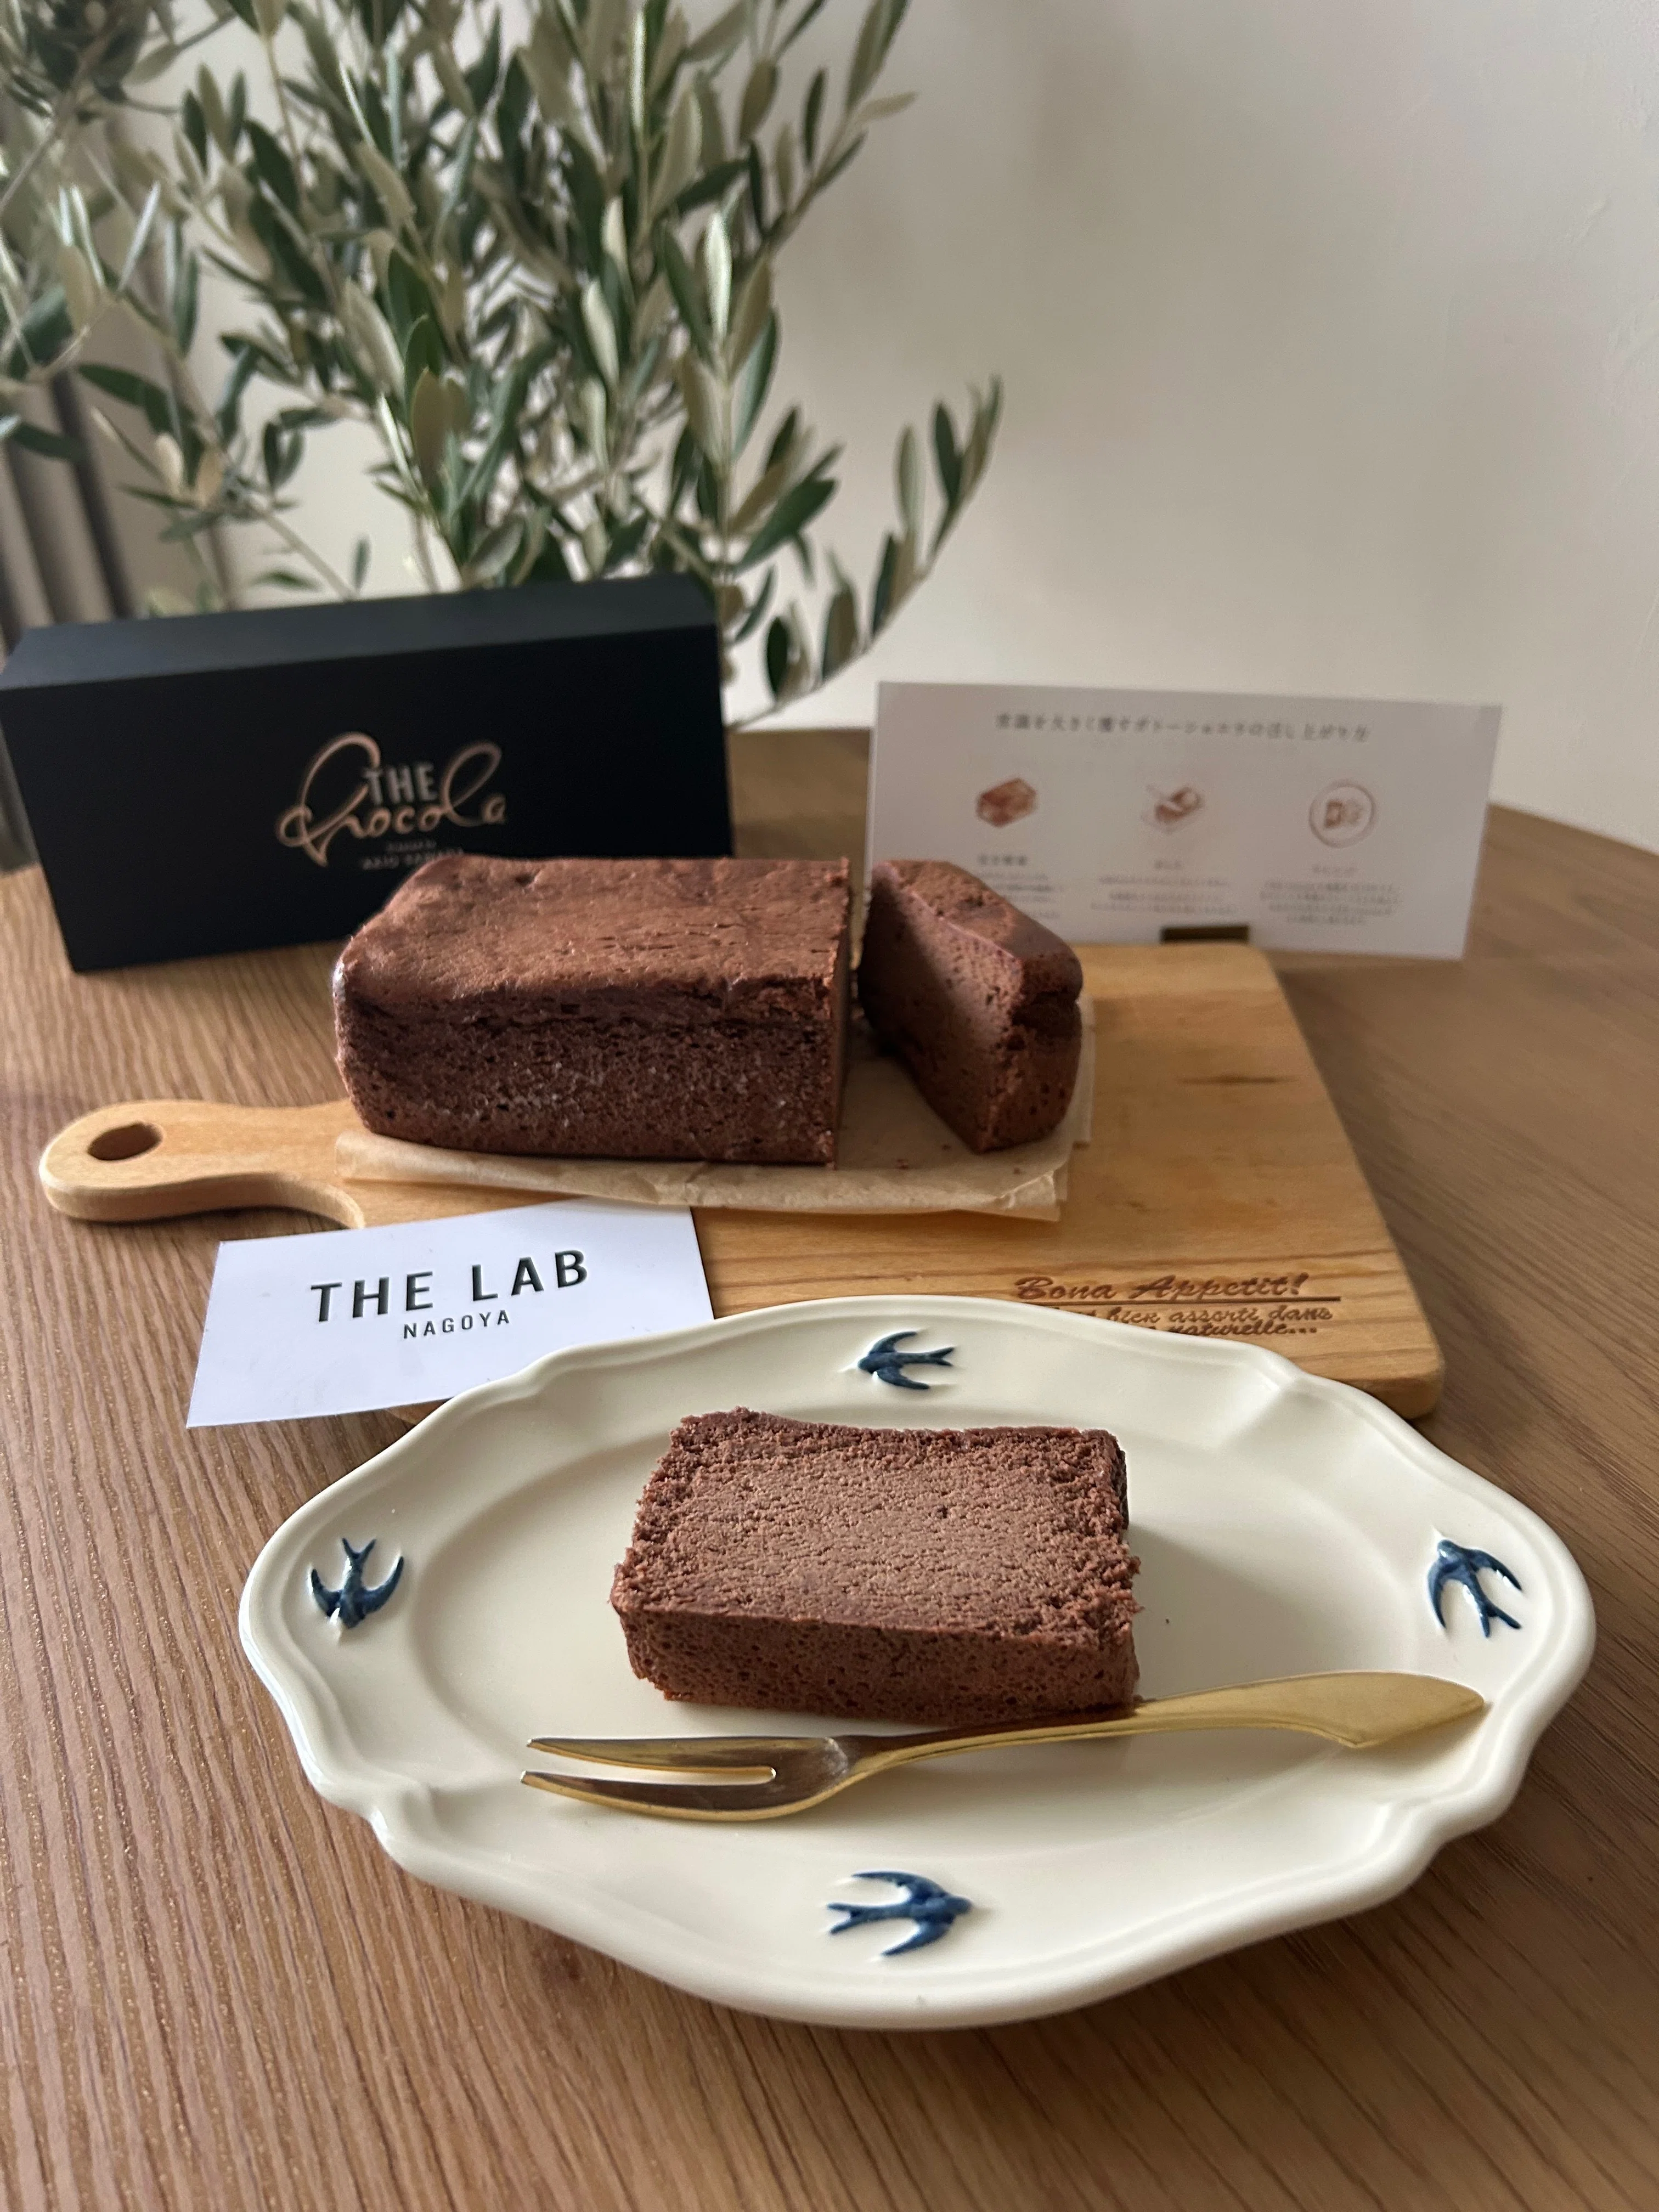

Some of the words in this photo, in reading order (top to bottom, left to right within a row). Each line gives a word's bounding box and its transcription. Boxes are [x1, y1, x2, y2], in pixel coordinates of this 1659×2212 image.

[362, 761, 438, 805] THE
[311, 1271, 433, 1323] THE
[471, 1249, 588, 1302] LAB
[1014, 1276, 1118, 1300] Bona
[1127, 1272, 1309, 1302] Appetit!
[403, 1310, 510, 1339] NAGOYA
